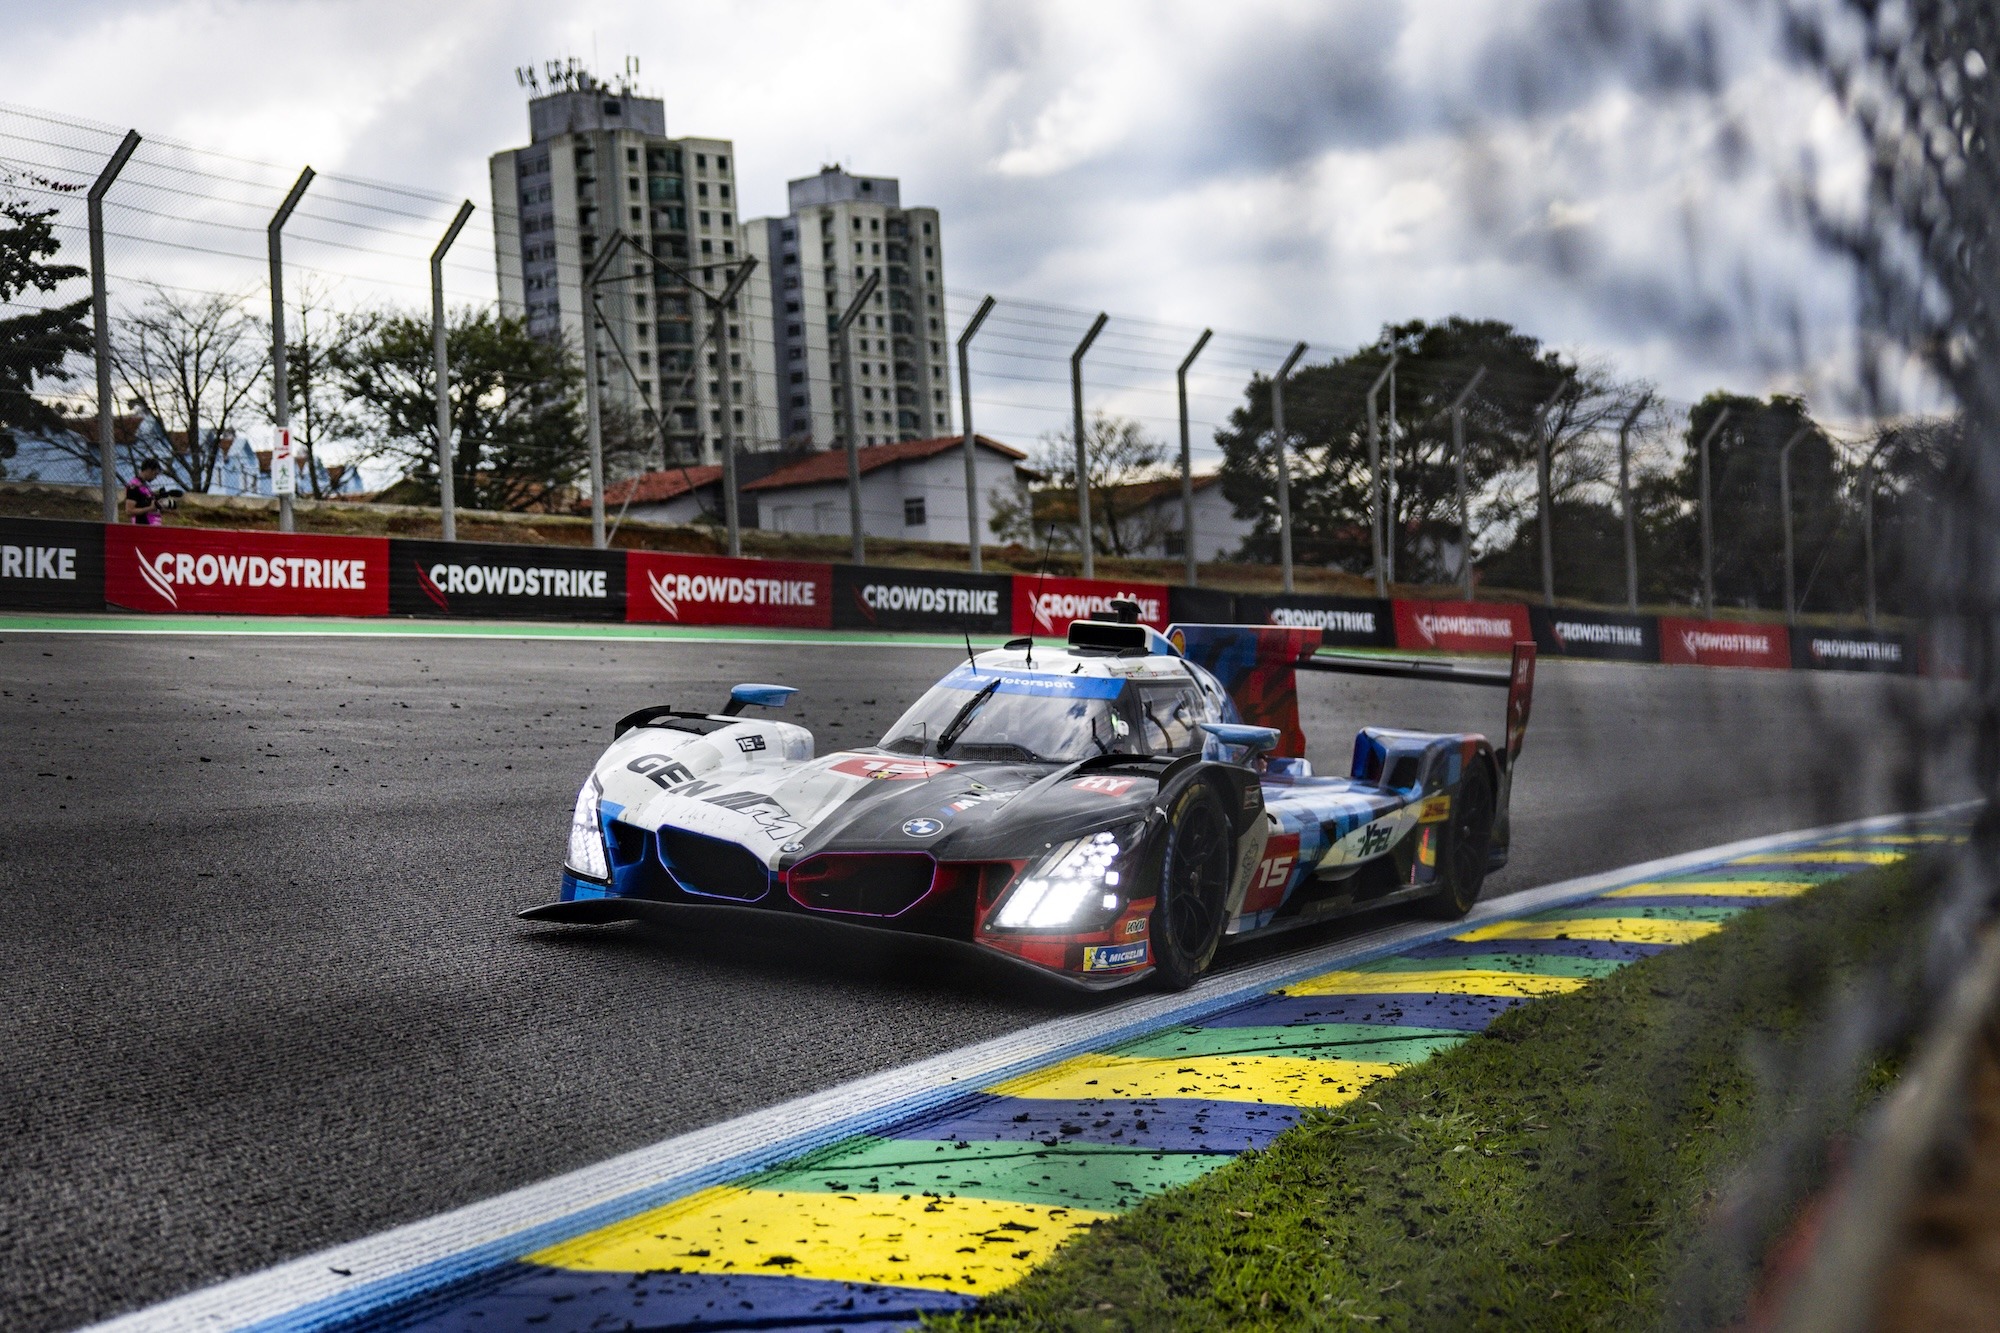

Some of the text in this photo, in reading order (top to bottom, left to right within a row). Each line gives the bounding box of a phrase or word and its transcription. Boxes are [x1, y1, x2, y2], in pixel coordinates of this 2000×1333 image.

[155, 553, 366, 589] CROWDSTRIKE
[429, 564, 606, 598] CROWDSTRIKE
[661, 574, 815, 606] CROWDSTRIKE
[862, 585, 998, 614] CROWDSTRIKE
[1040, 593, 1160, 622] CROWDSKE
[1271, 608, 1376, 633] CROWDSTRIKE
[1423, 614, 1512, 638] CROWDSTRIKE
[1555, 622, 1642, 646] CROWDSTRIKE
[1687, 632, 1769, 654] CROWDSTRIKE
[737, 737, 756, 751] 15
[627, 753, 722, 797] GEN
[862, 760, 936, 773] 15
[1077, 777, 1132, 792] HY
[1358, 823, 1393, 858] XPEL
[1258, 856, 1293, 889] 15
[1109, 948, 1144, 962] MICHELIN
